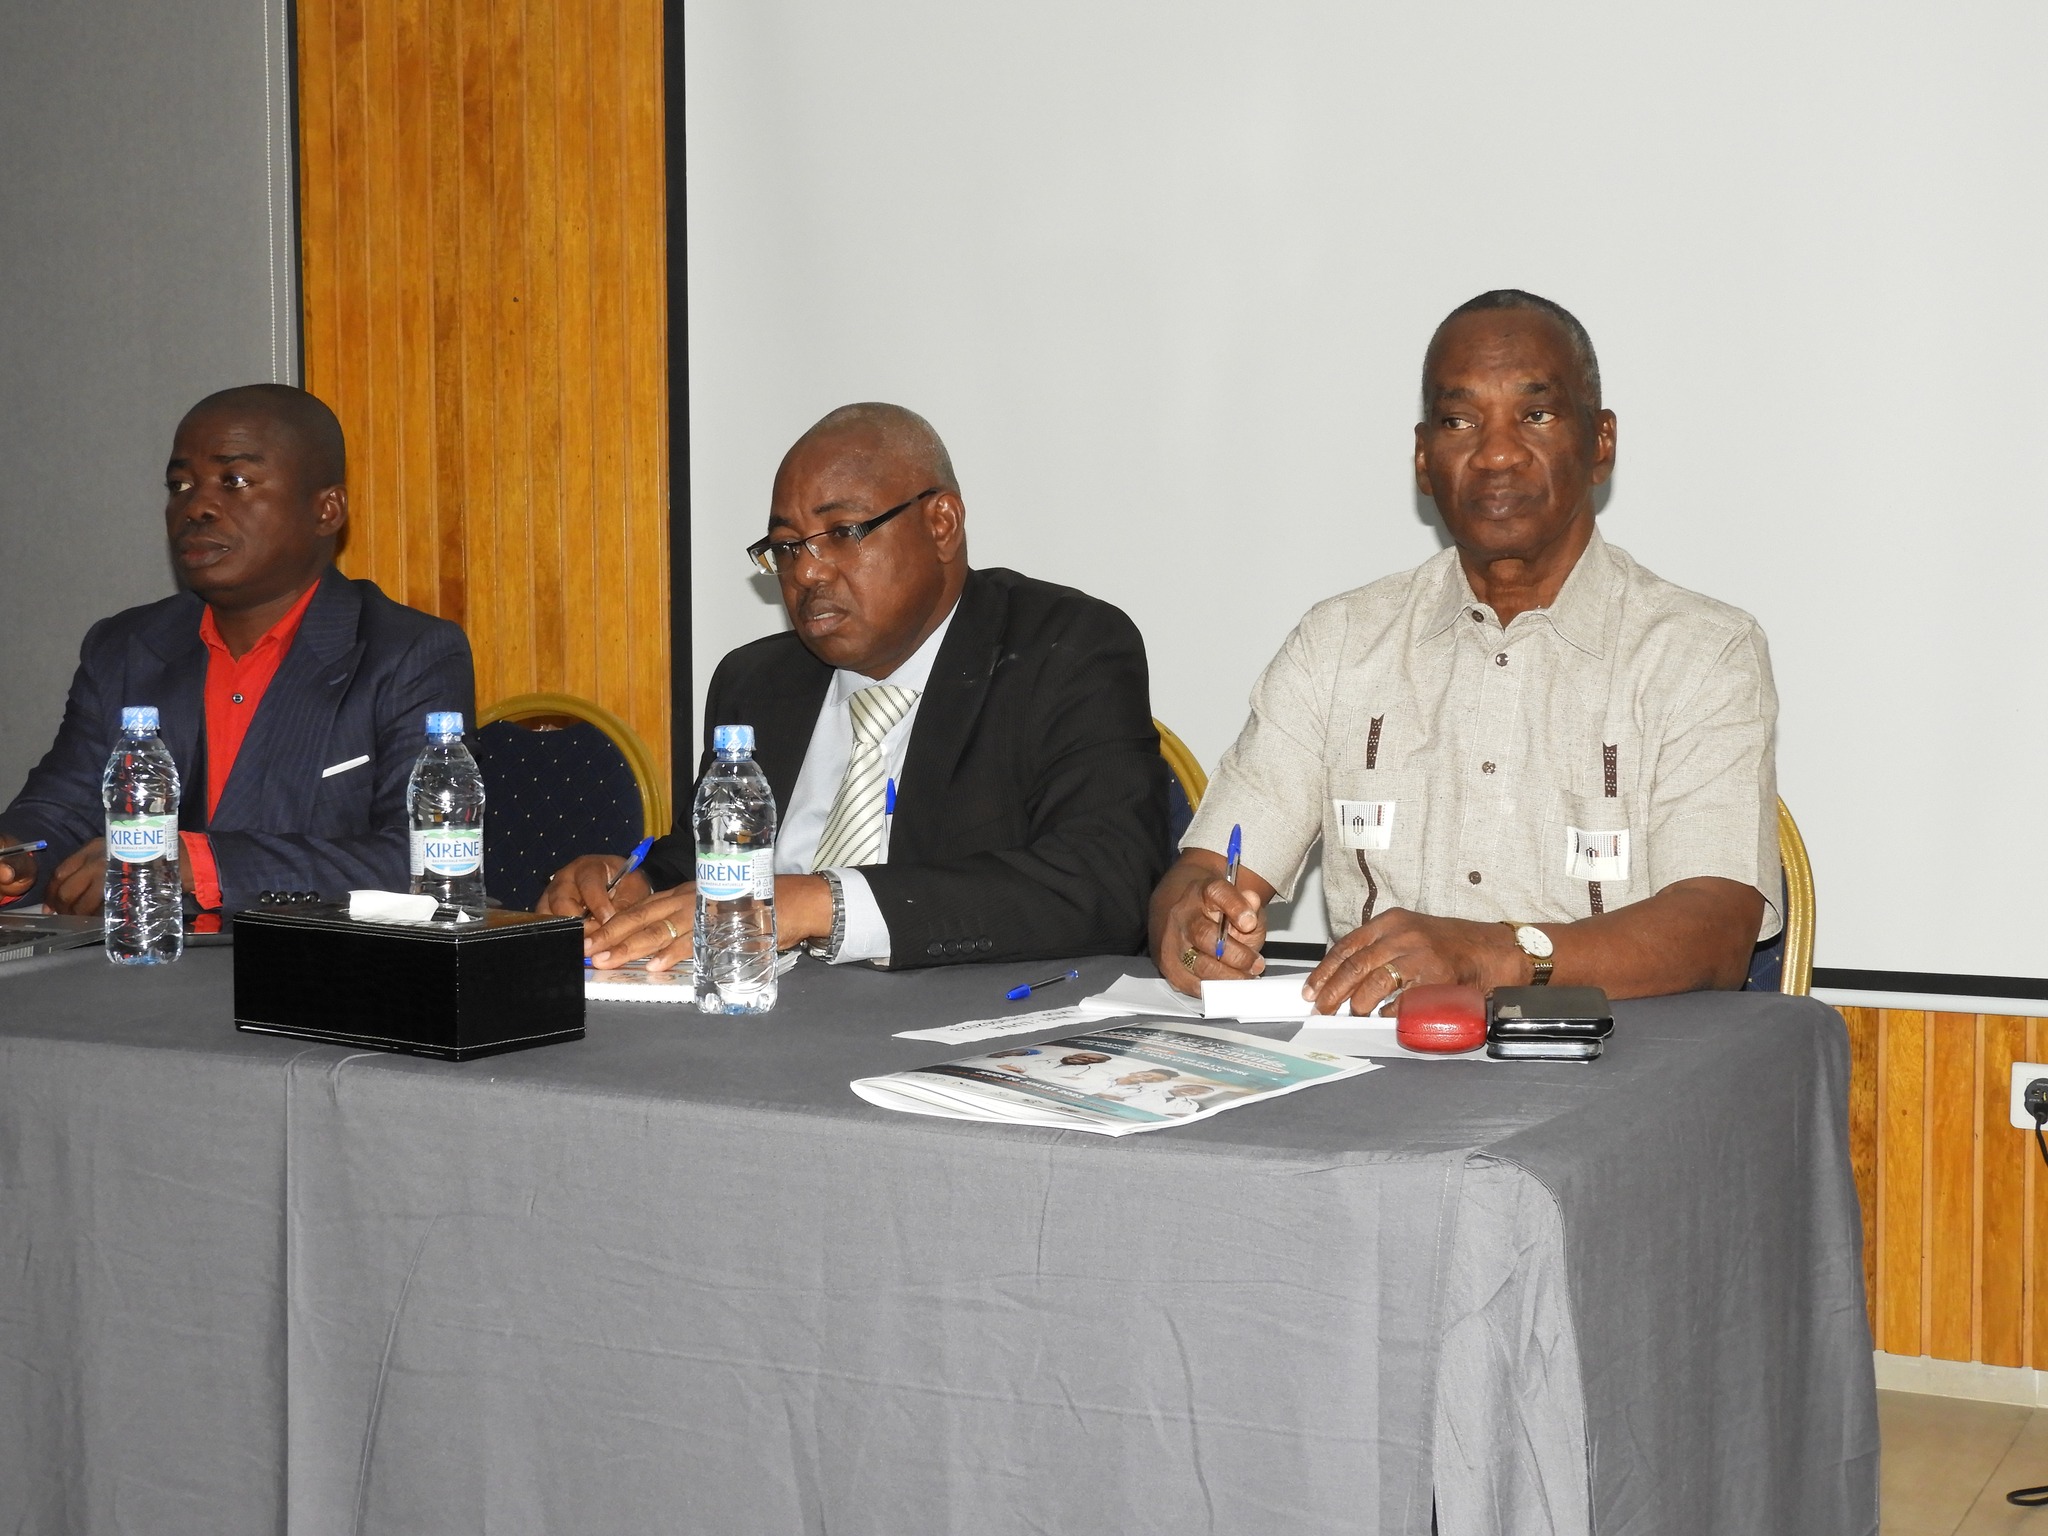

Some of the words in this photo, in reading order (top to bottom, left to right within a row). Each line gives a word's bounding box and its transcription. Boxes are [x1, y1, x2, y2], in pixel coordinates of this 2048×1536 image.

[110, 829, 164, 845] KIRÈNE
[425, 840, 479, 858] KIRÈNE
[697, 862, 751, 881] KIRÈNE
